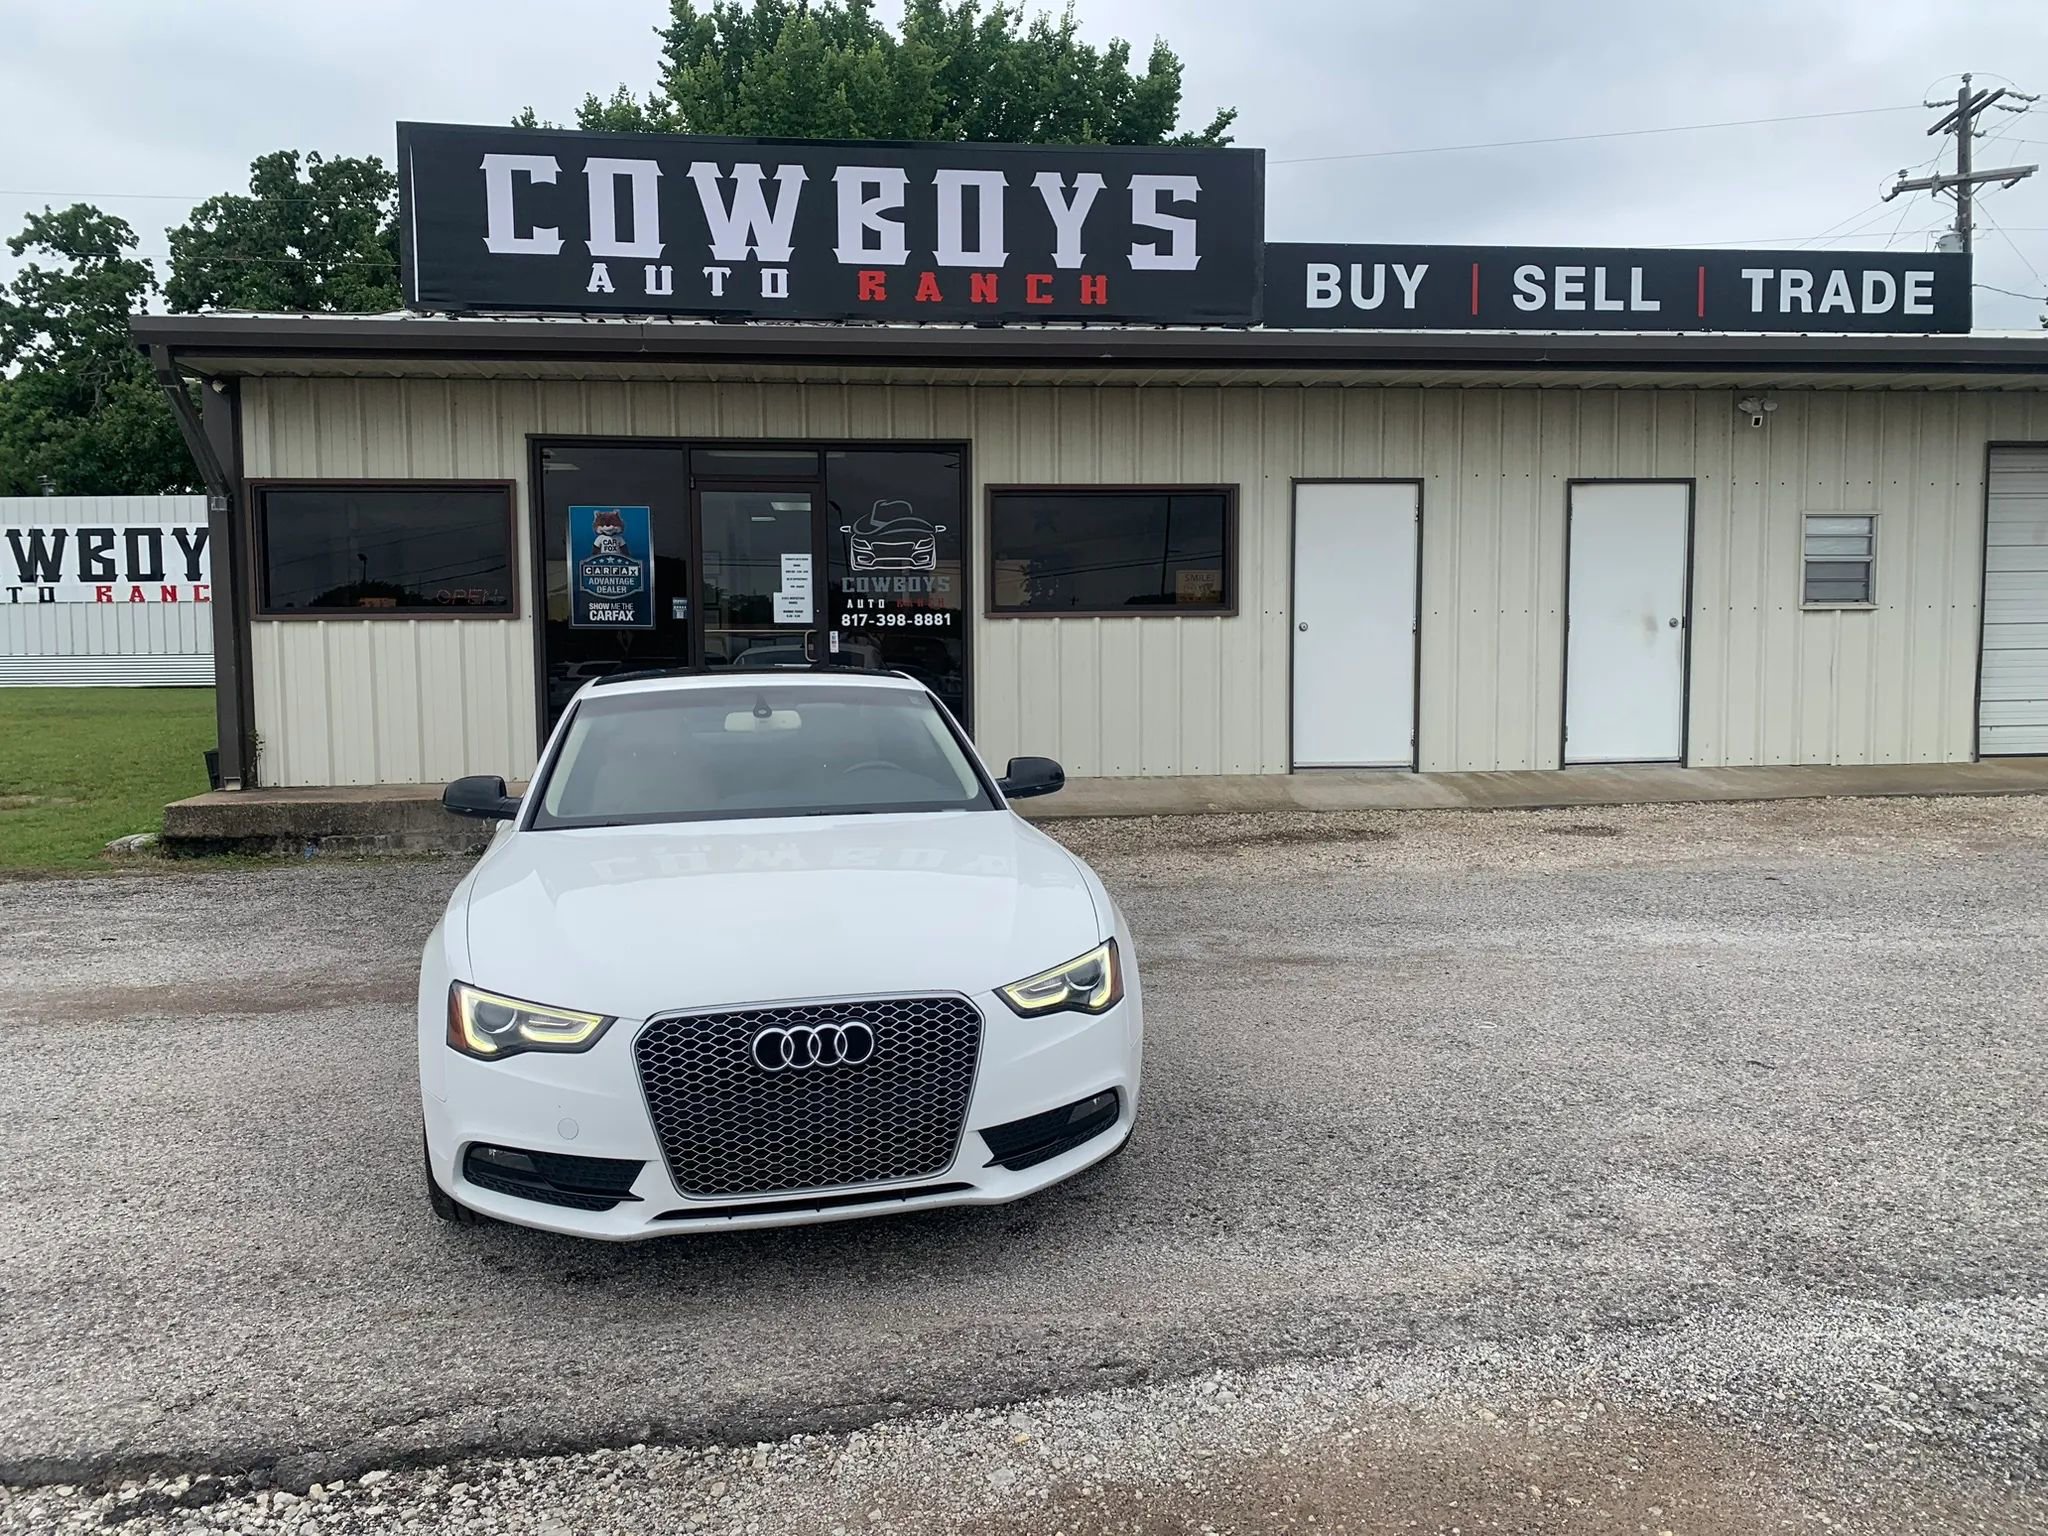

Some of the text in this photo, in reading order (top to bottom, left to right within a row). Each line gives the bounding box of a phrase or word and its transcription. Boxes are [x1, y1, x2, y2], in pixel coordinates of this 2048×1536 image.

[479, 153, 1203, 271] COWBOYS
[586, 262, 1109, 305] AUTO RANCH
[1304, 263, 1936, 316] BUY SELL TRADE
[585, 567, 639, 576] CARFAX
[588, 577, 635, 586] ADVANTAGE
[841, 576, 951, 593] COWBOYS
[596, 585, 627, 594] DEALER
[588, 602, 634, 610] SHOW ME THE
[847, 599, 885, 609] AUTO
[589, 610, 636, 622] CARFAX
[841, 613, 951, 626] 817-398-8881
